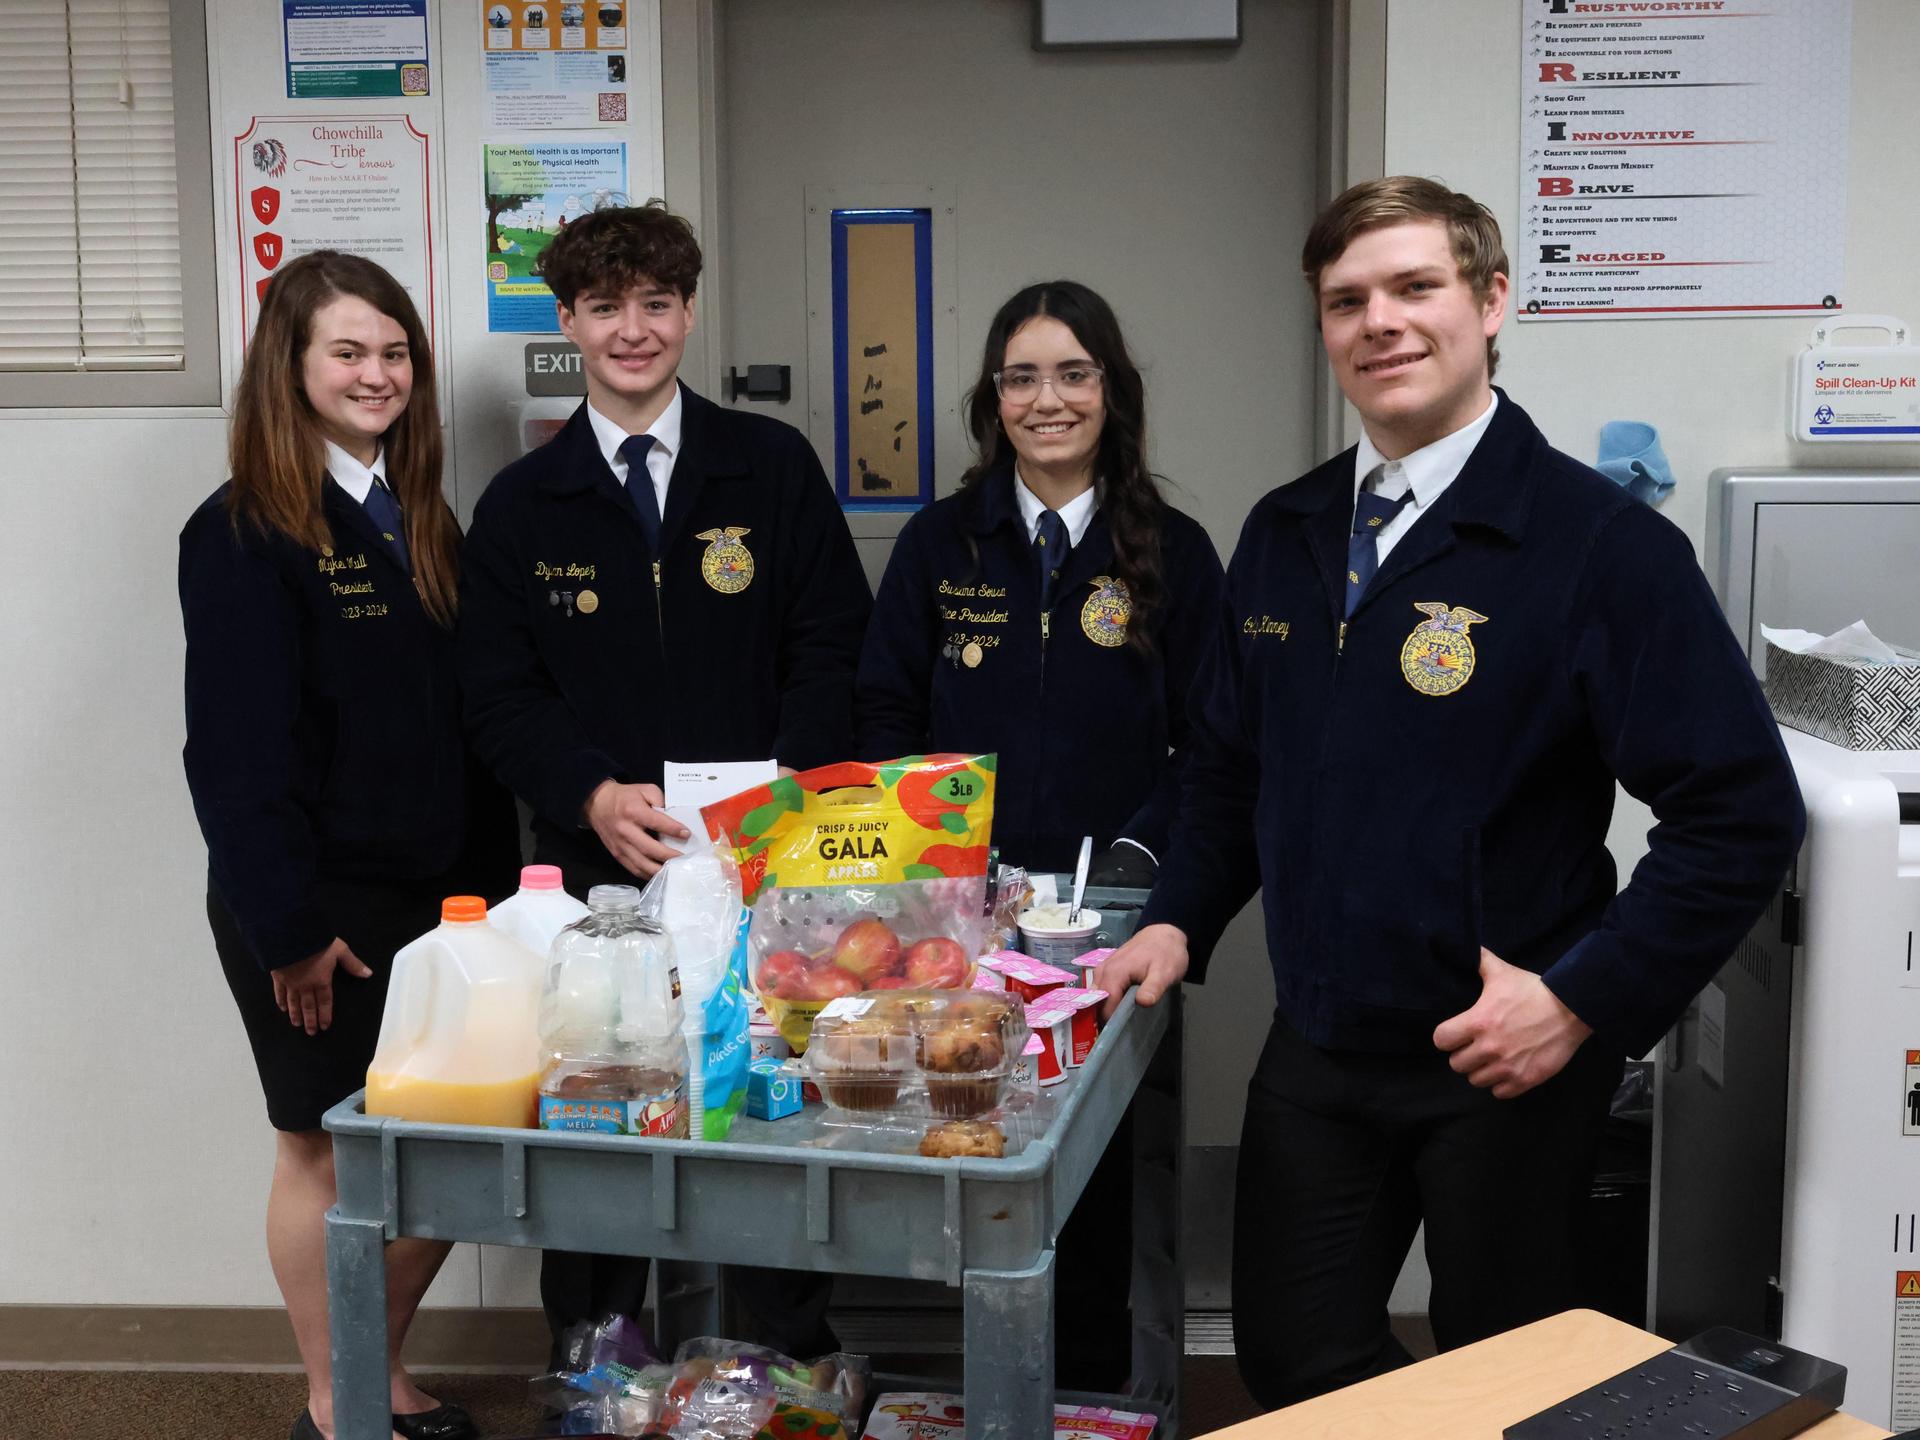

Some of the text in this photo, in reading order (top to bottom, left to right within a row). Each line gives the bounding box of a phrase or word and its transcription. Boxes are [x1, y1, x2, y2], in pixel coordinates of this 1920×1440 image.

[312, 126, 383, 141] Chowchilla
[330, 145, 366, 158] Tribe
[581, 148, 619, 157] Important
[359, 157, 395, 169] knows
[542, 159, 572, 167] Physical
[262, 200, 270, 214] S
[262, 244, 274, 257] M
[534, 354, 582, 372] EXIT
[1816, 377, 1916, 390] Spill Clean-Up Kit
[566, 563, 595, 581] Lopez
[330, 580, 375, 596] President
[959, 608, 1008, 622] President
[1427, 642, 1451, 655] FFA
[817, 822, 889, 833] CRISP & JUICY
[819, 836, 888, 860] GALA
[828, 863, 878, 878] APPLES
[546, 1104, 621, 1118] LANGERS
